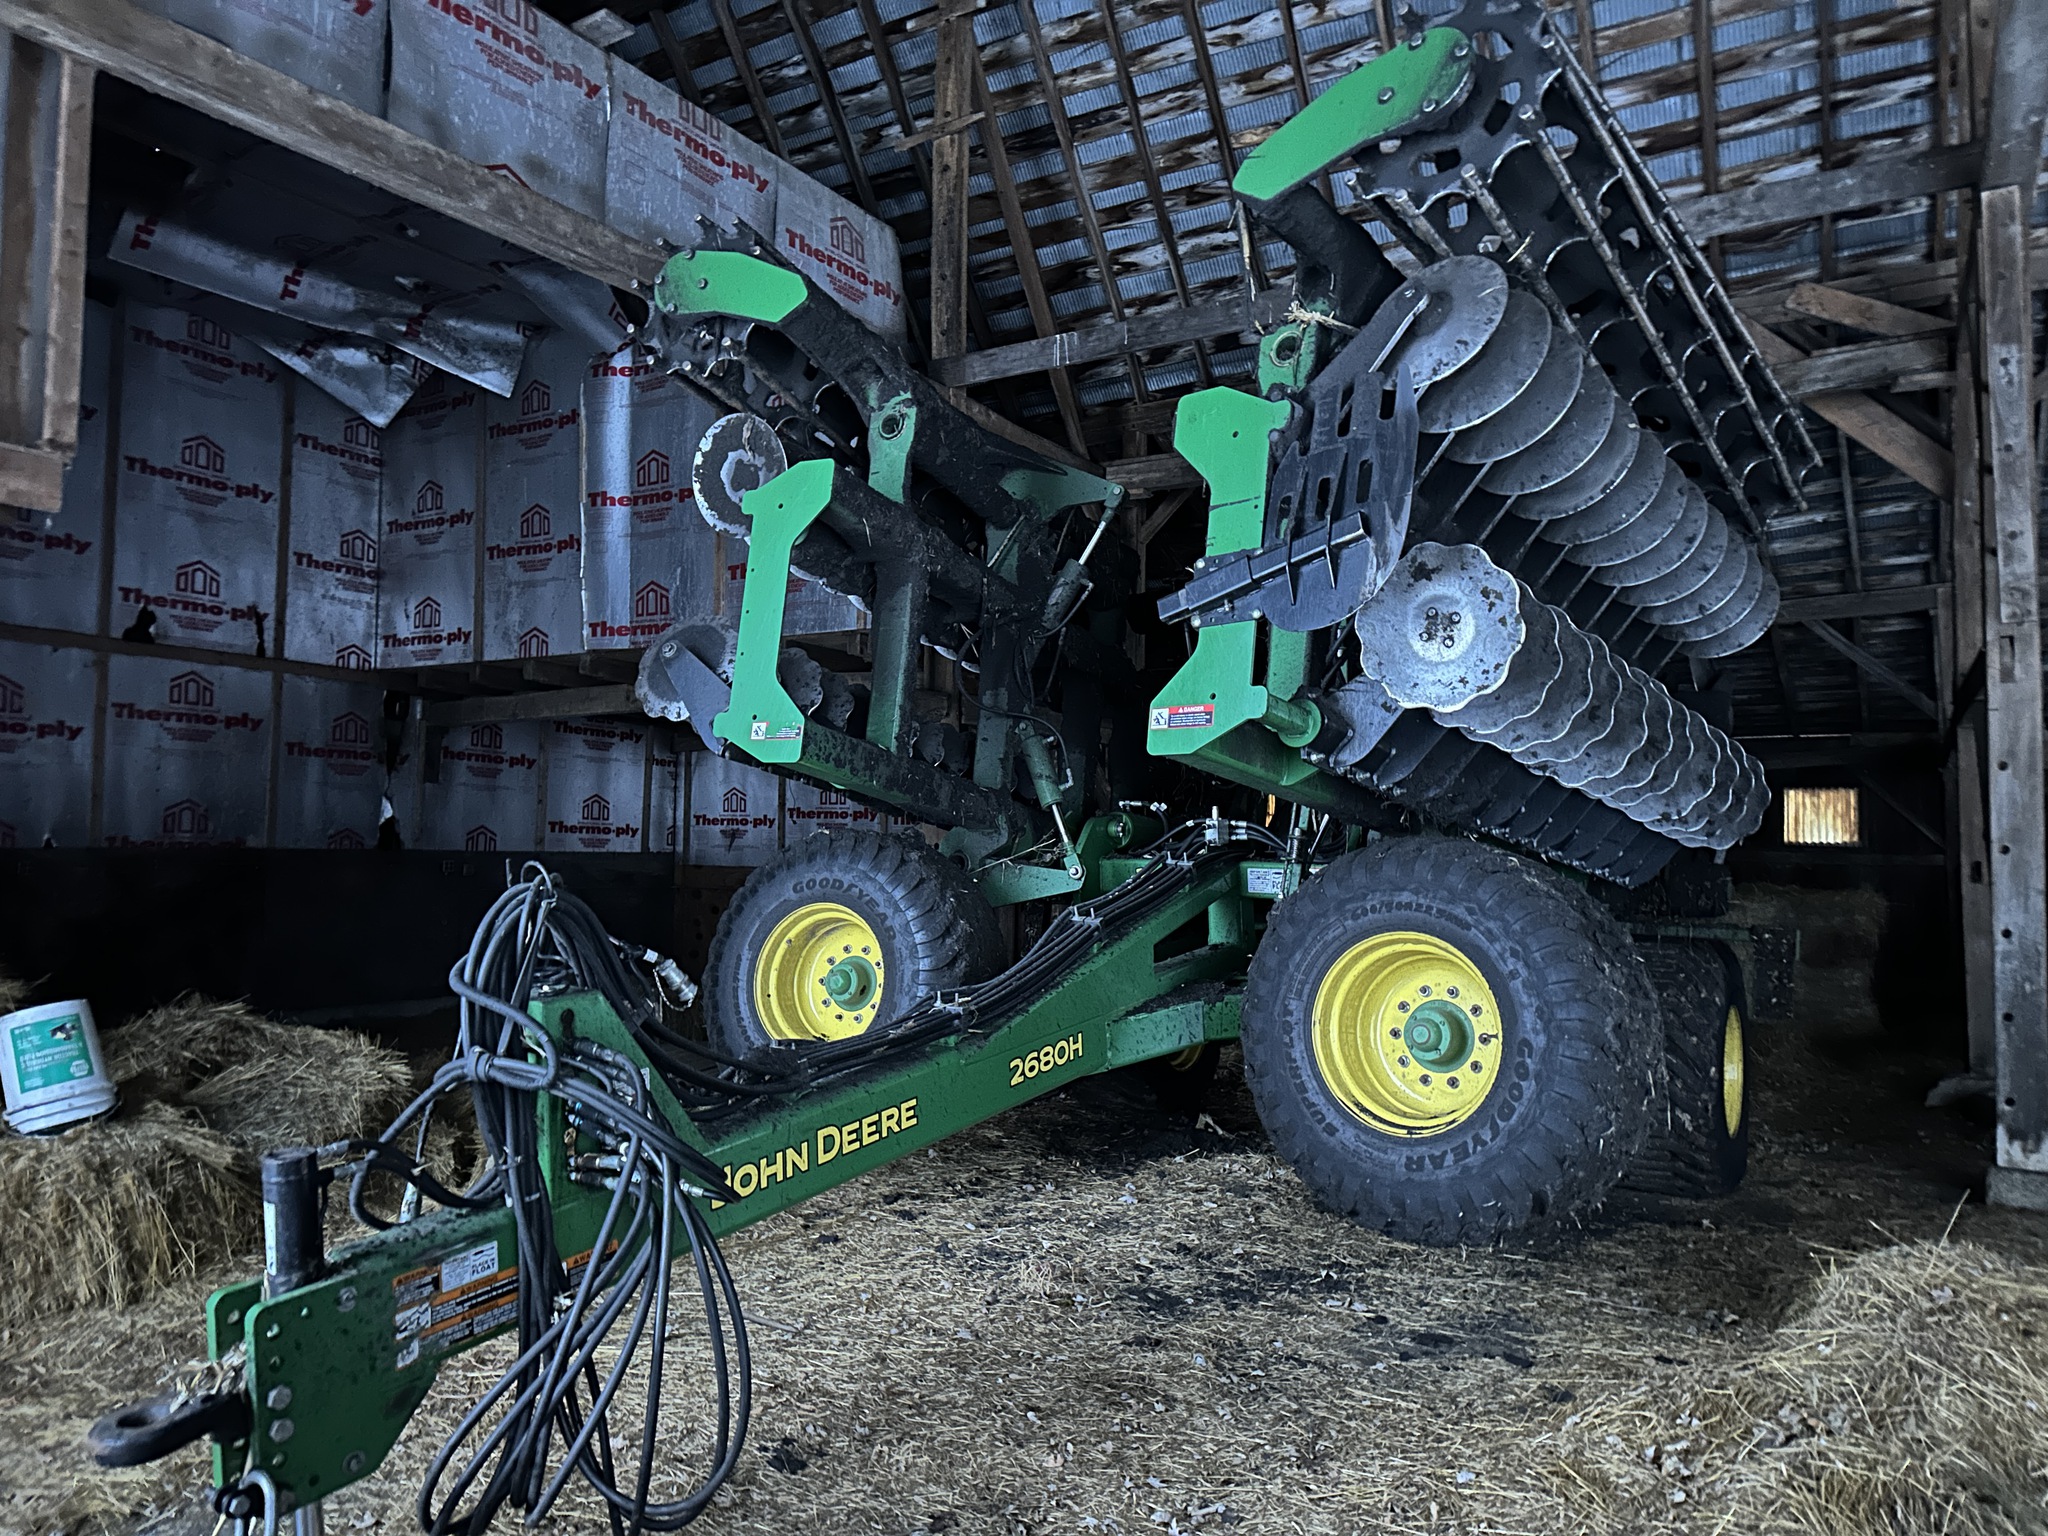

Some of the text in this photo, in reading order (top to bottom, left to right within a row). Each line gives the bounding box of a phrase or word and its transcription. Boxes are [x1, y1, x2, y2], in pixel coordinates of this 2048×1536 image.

[792, 876, 897, 939] GOODYEAR
[1009, 1032, 1084, 1087] 2680H
[816, 1096, 918, 1166] DEERE
[1403, 1036, 1533, 1173] GOODYEAR
